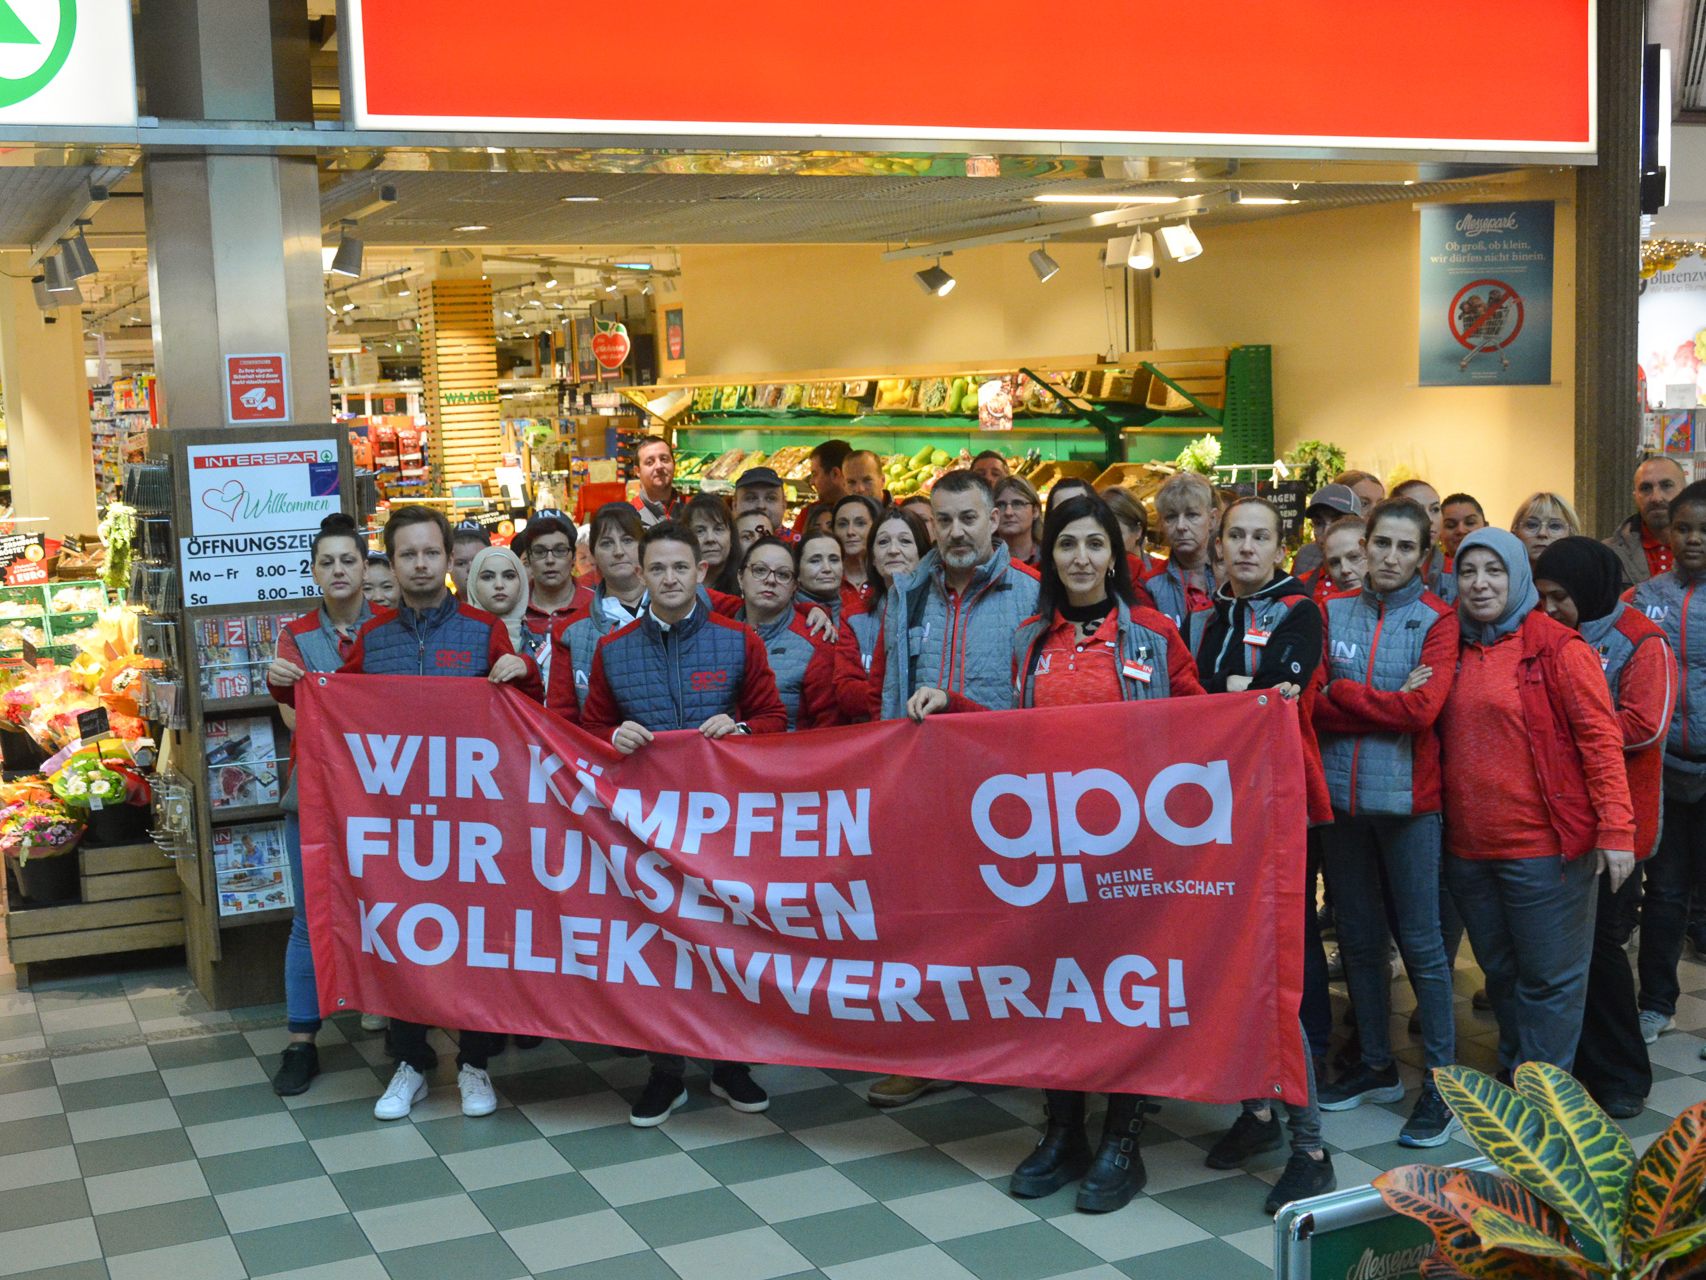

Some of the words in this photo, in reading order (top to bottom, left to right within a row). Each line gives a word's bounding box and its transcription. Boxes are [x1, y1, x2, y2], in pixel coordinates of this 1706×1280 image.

[1445, 241, 1460, 251] Ob
[1462, 240, 1486, 252] groß,
[1488, 241, 1501, 250] ob
[1502, 240, 1531, 251] klein,
[1430, 254, 1447, 264] wir
[1449, 252, 1482, 263] dürfen
[1484, 252, 1510, 262] nicht
[444, 390, 497, 405] WAAGE
[205, 452, 317, 467] INTERSPAR
[222, 488, 329, 520] Willkommen
[1267, 493, 1297, 503] SAGEN
[537, 510, 562, 519] IN
[458, 520, 481, 531] IN
[189, 570, 211, 582] Mo
[226, 568, 239, 580] Fr
[256, 565, 286, 578] 8.00
[191, 594, 208, 606] Sa
[258, 587, 288, 600] 8.00
[1646, 604, 1669, 619] IN
[1331, 639, 1357, 659] IN
[690, 669, 728, 691] gpa
[206, 721, 227, 734] IN
[344, 733, 504, 801] WIR
[528, 744, 873, 857] KÄMPFEN
[215, 832, 231, 842] IN
[971, 760, 1233, 907] gpa
[346, 804, 507, 885] FÜR
[530, 826, 878, 941] UNSEREN
[1096, 867, 1154, 886] MEINE
[1098, 879, 1236, 899] GEWERKSCHAFT
[359, 899, 1190, 1029] KOLLEKTIVVERTRAG!
